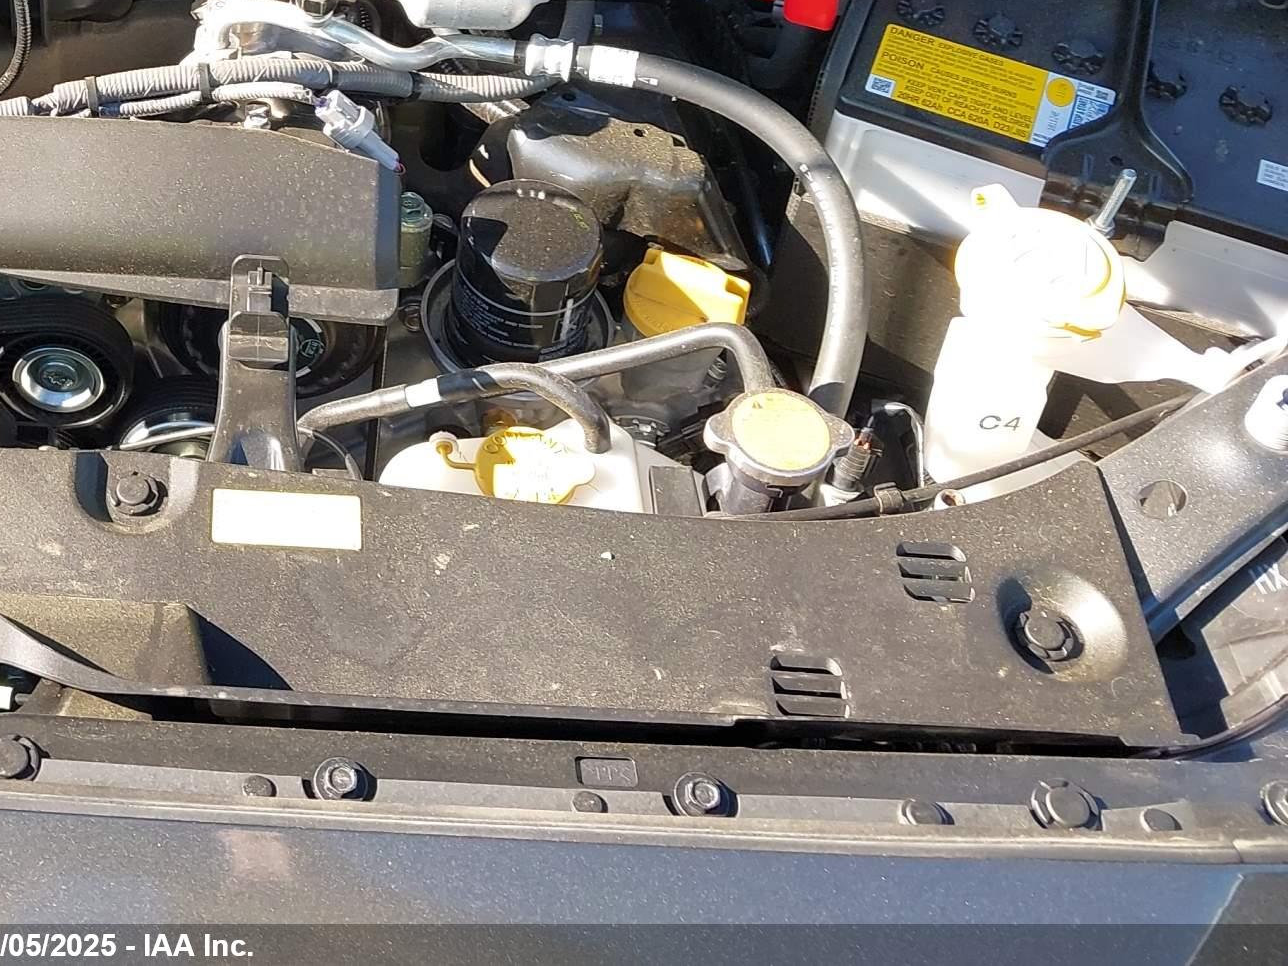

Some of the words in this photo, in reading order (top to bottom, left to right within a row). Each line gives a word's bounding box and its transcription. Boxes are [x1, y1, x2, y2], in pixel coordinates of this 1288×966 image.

[889, 27, 935, 45] DANGER
[880, 51, 925, 69] POISON
[903, 85, 925, 95] KEEP
[923, 91, 942, 100] OUT
[952, 99, 980, 112] REACH
[979, 108, 993, 116] OF
[991, 112, 1031, 128] CHILDREN
[906, 79, 927, 89] KEEP
[926, 85, 946, 95] VENT
[946, 91, 969, 102] CAPS
[967, 98, 992, 109] TIGHT
[991, 105, 1009, 114] AND
[1007, 110, 1034, 122] LEVEL
[945, 106, 967, 118] CCA
[979, 415, 1021, 431] C4
